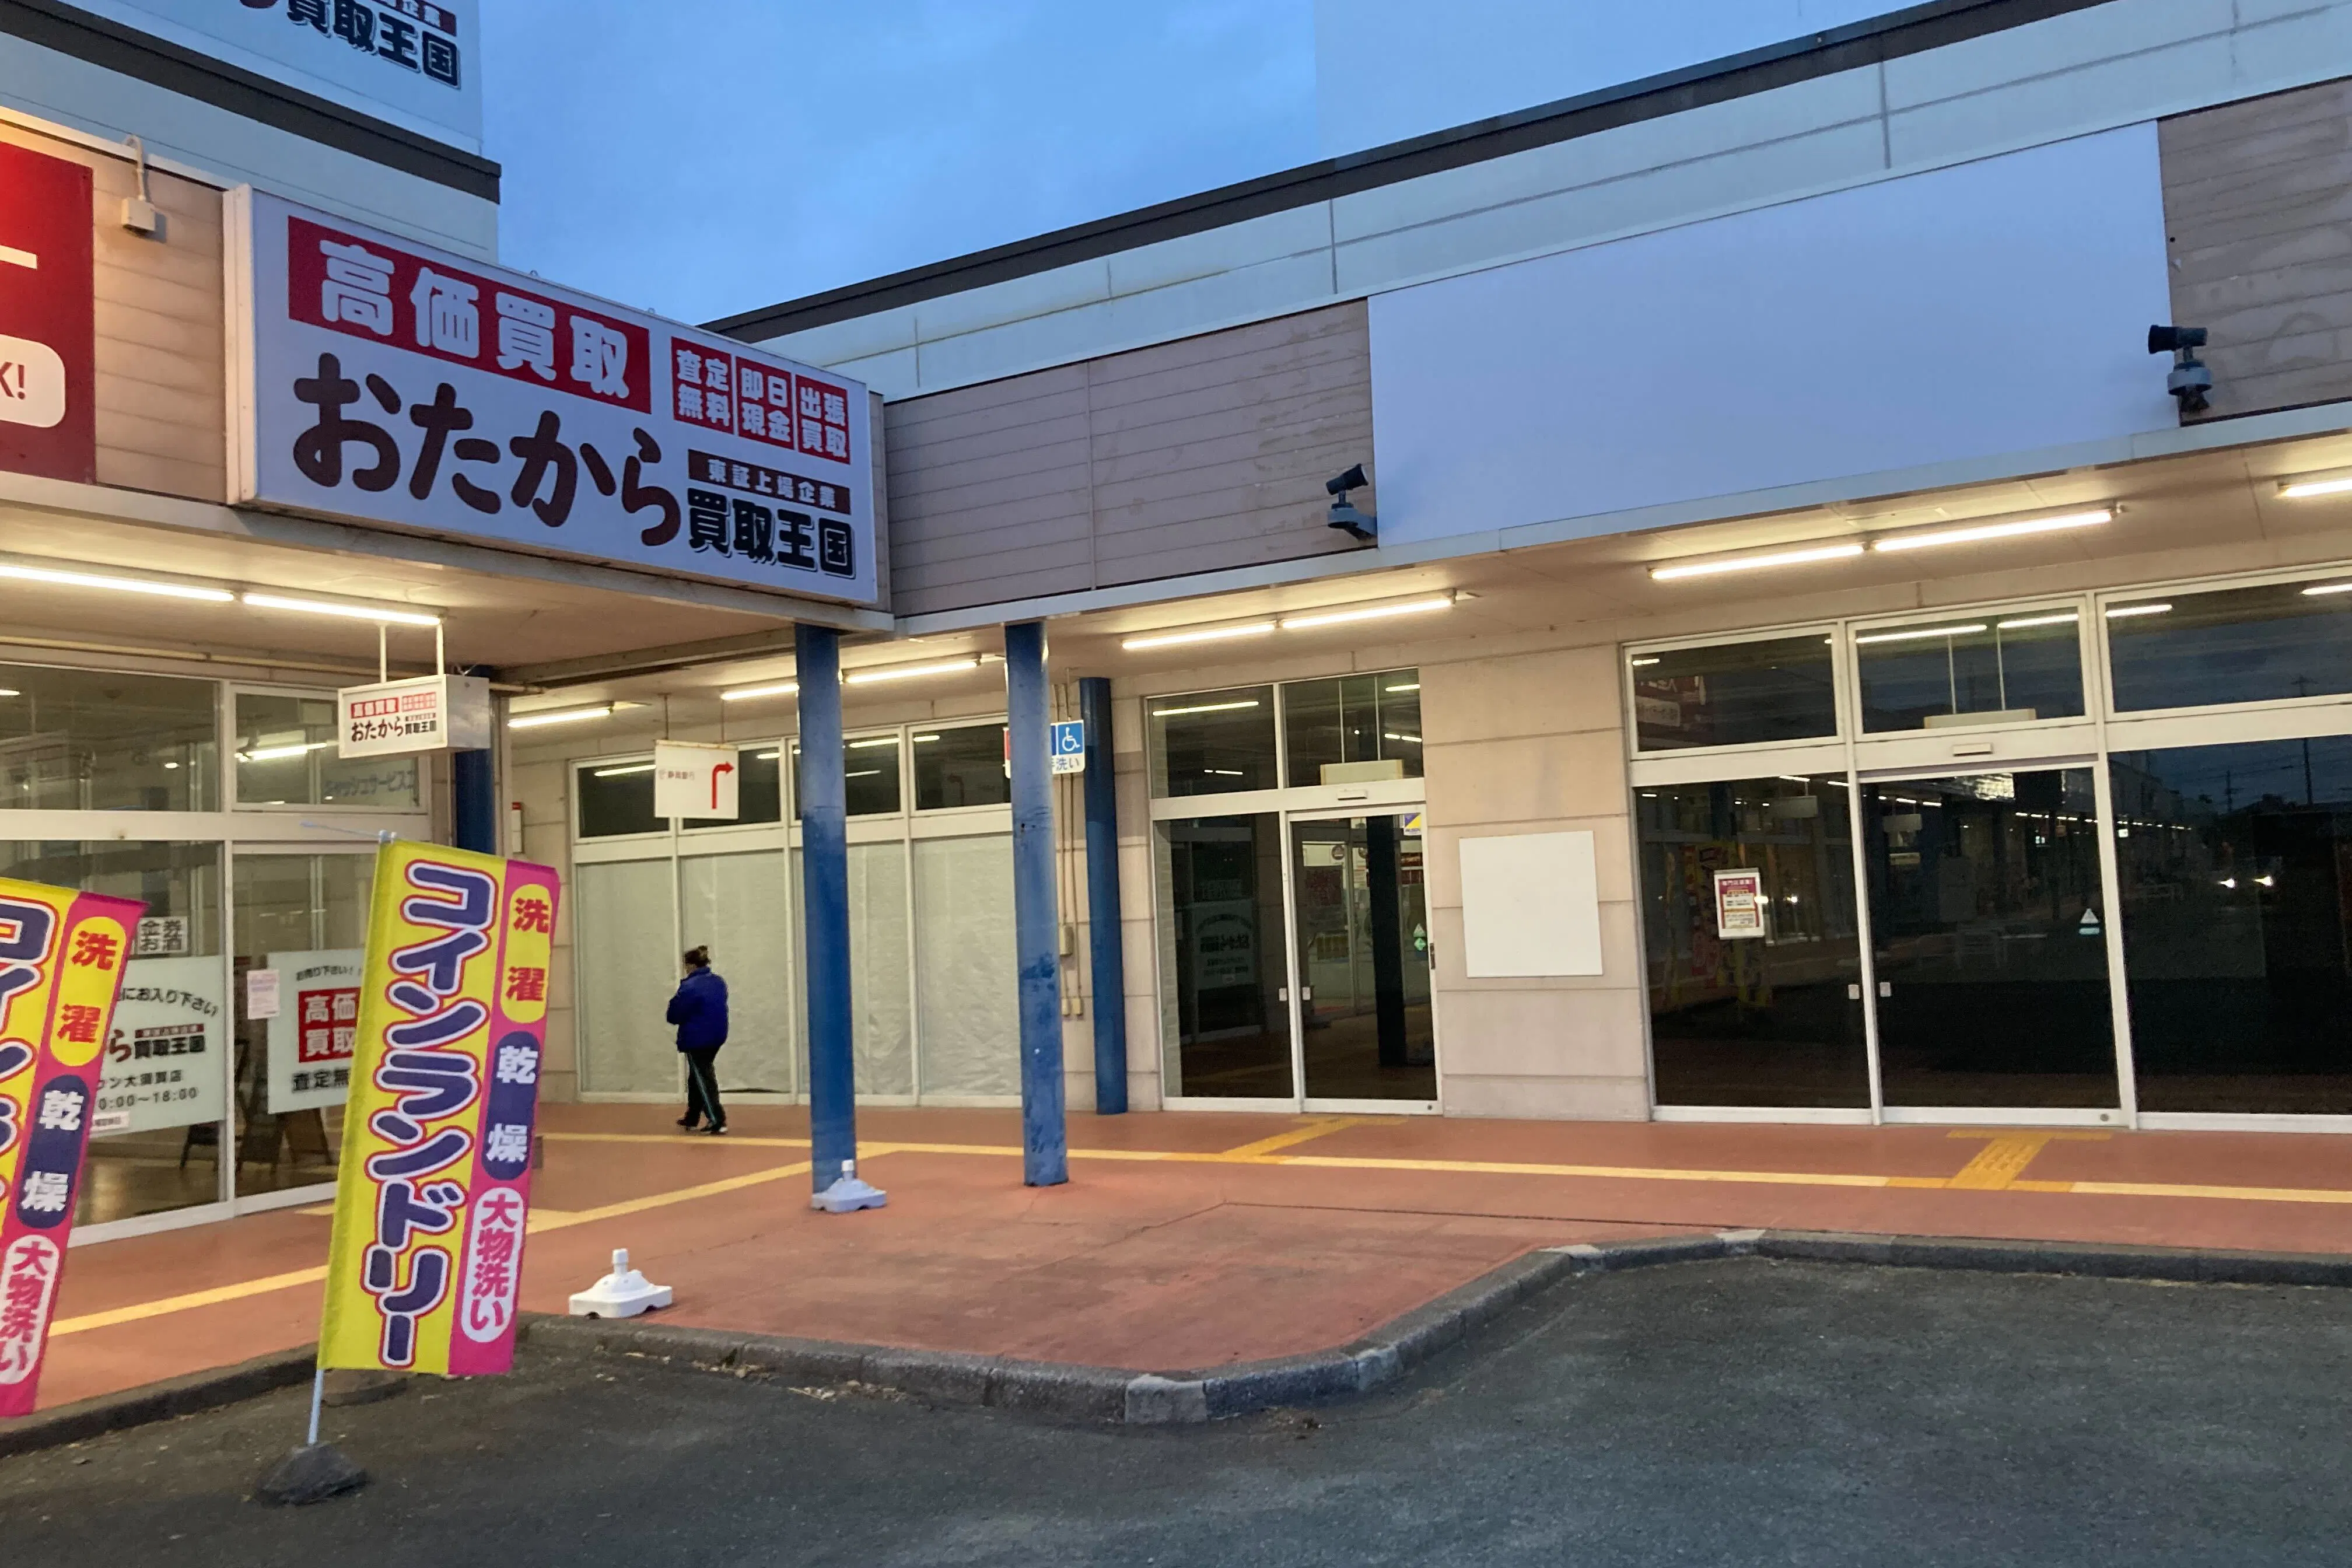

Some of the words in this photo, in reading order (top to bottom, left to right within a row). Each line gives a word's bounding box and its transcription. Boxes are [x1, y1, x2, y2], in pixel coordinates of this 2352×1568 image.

[319, 240, 629, 398] 高価買取
[677, 349, 729, 391] 査定
[740, 368, 788, 408] 即日
[677, 383, 730, 427] 無料
[741, 403, 790, 442] 現金
[800, 386, 845, 426] 出張
[800, 419, 848, 459] 買取
[293, 352, 681, 547] おたから
[688, 488, 856, 579] 買取王国
[708, 459, 836, 509] 東証上場企業
[351, 716, 404, 743] おたから
[505, 897, 551, 1002] 洗濯
[57, 930, 118, 1044] 洗濯
[120, 988, 219, 1017] にお入り下さい
[304, 993, 356, 1024] 高価
[305, 1027, 356, 1058] 買取
[362, 861, 497, 1366] コインランドリー
[485, 1045, 537, 1163] 乾燥
[20, 1089, 85, 1212] 乾燥
[469, 1194, 520, 1330] 大物洗い
[0, 1240, 54, 1371] 大物洗い
